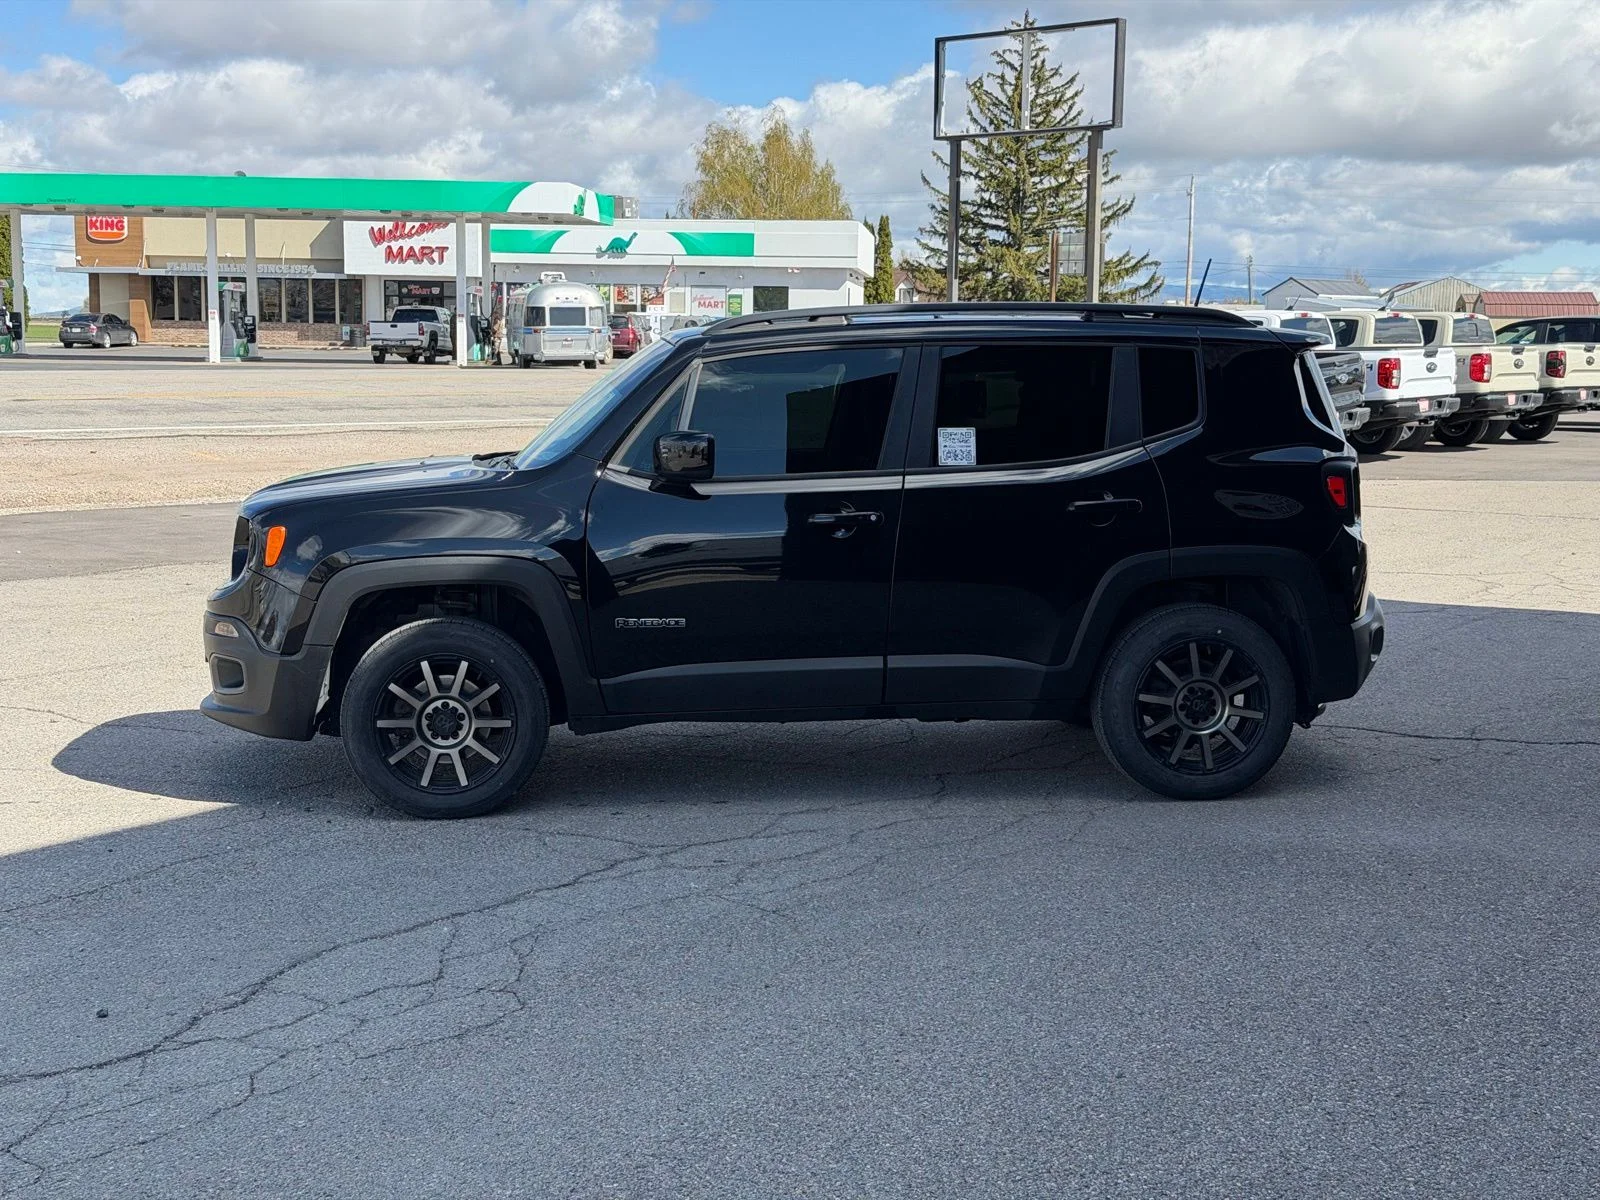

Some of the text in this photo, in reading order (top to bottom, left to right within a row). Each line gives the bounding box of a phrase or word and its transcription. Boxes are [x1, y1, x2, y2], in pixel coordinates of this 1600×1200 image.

[89, 219, 125, 231] KING
[384, 245, 449, 265] MART
[257, 263, 289, 273] SINCE
[290, 264, 315, 274] 1954
[697, 300, 726, 309] MART
[615, 617, 686, 629] RENEGADE
